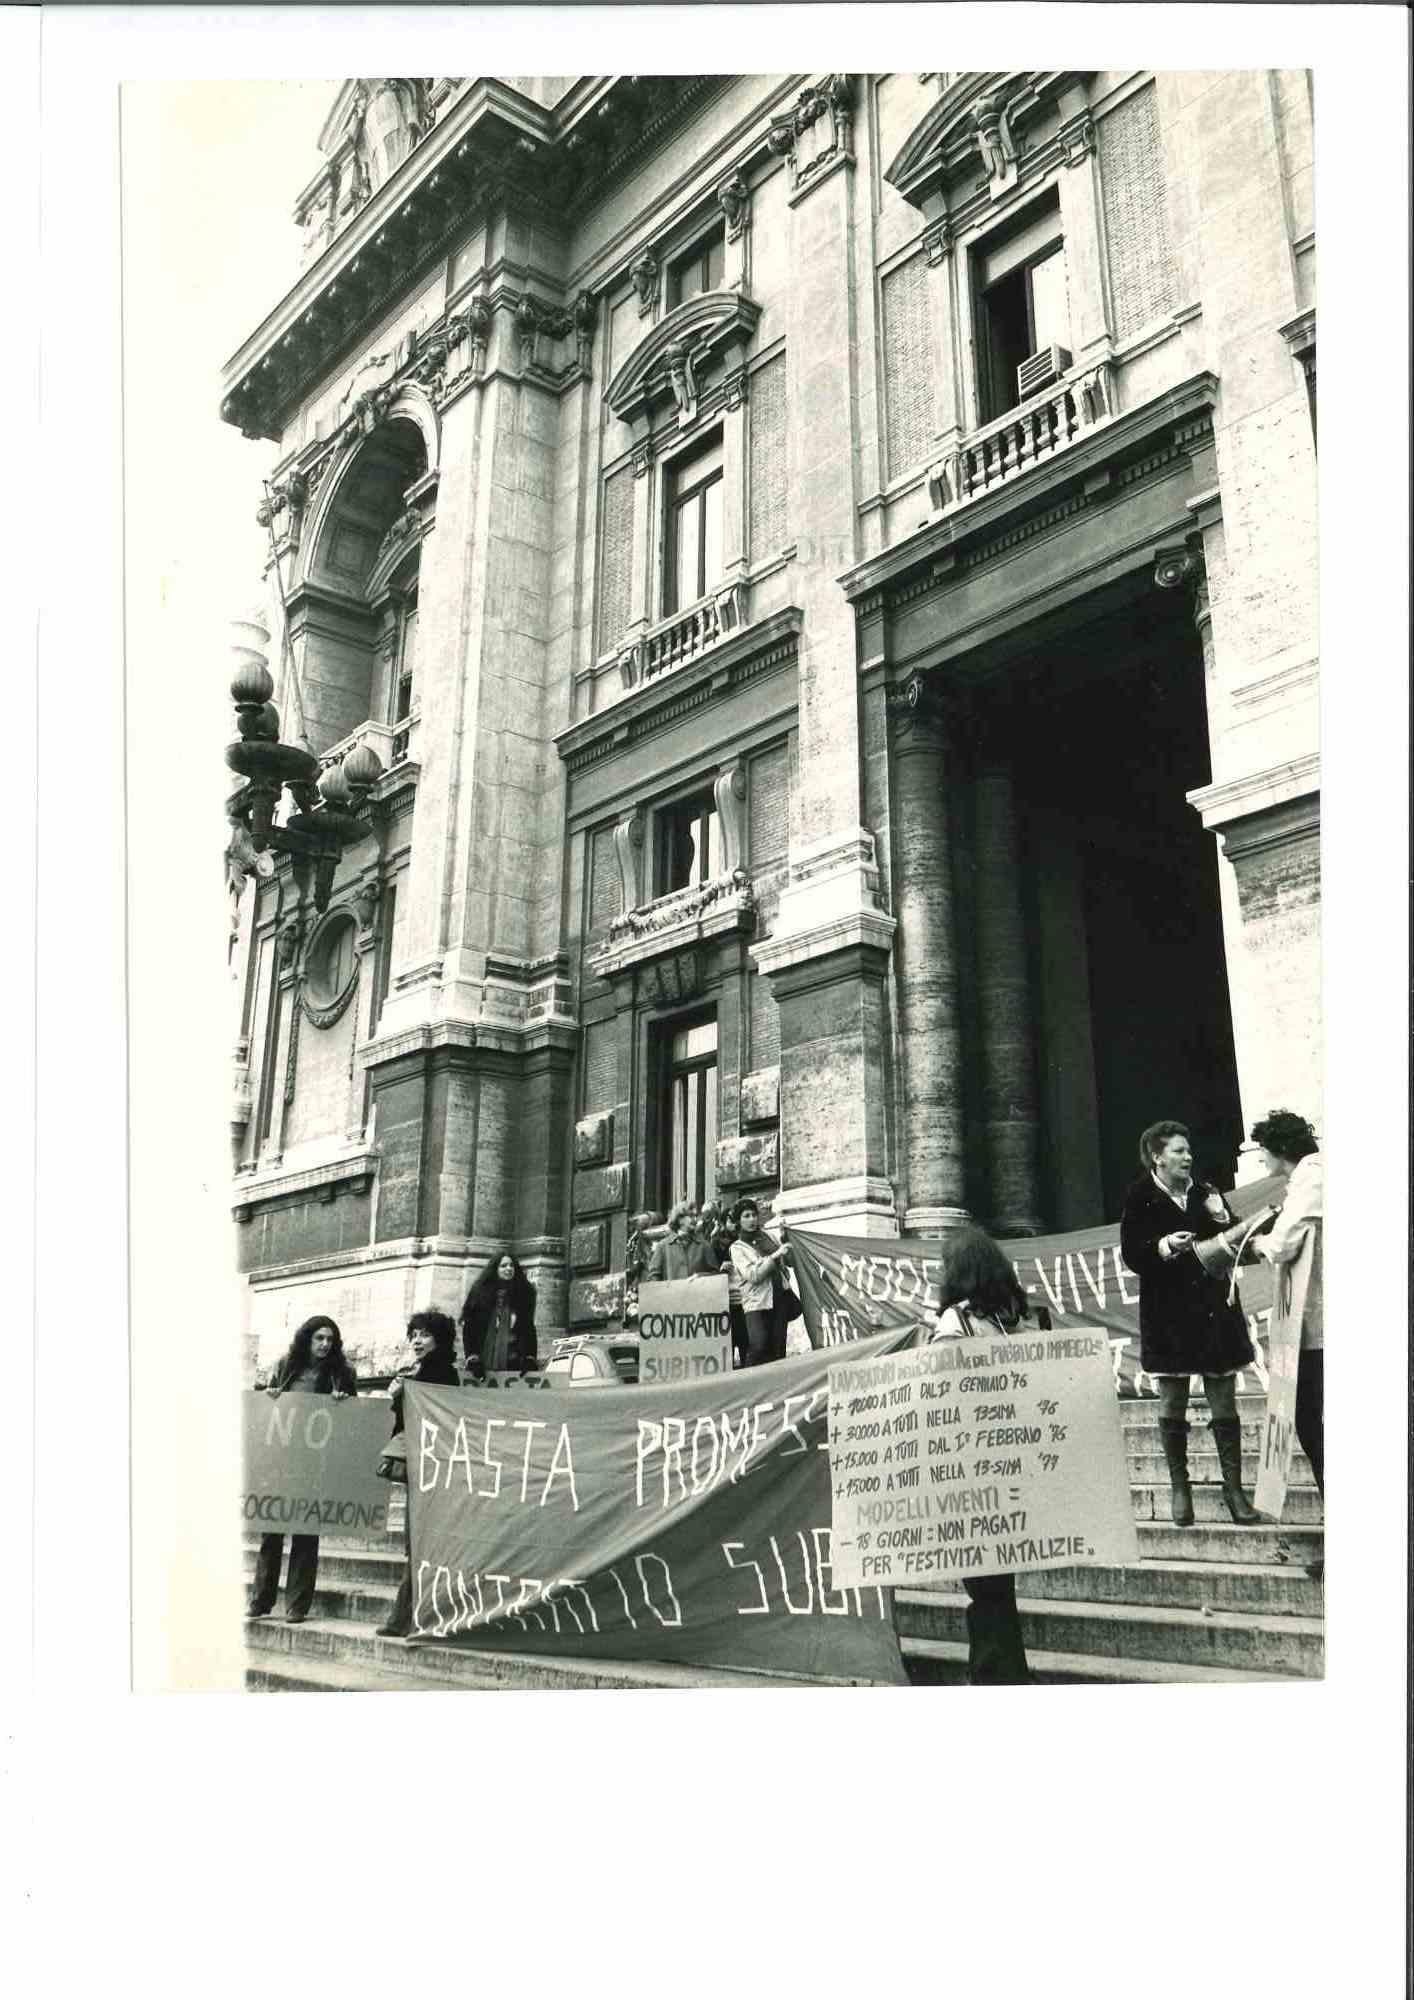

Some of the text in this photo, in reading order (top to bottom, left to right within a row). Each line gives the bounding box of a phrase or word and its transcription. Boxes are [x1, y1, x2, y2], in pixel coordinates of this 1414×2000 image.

[640, 1311, 731, 1340] CONTRATTO
[888, 1384, 912, 1407] TUTTI
[920, 1382, 937, 1399] DAL
[959, 1373, 1007, 1392] GENNAIO
[264, 1406, 334, 1450] NO
[882, 1419, 891, 1436] A
[893, 1409, 919, 1434] TUTTI
[926, 1406, 961, 1427] NELLA
[883, 1446, 893, 1464] A
[894, 1439, 919, 1461] TUTTI
[928, 1437, 951, 1456] DAL
[975, 1425, 1042, 1448] FEBBRAIO
[419, 1416, 581, 1513] BASTA
[886, 1473, 894, 1491] A
[896, 1466, 920, 1488] TUTTI
[930, 1461, 965, 1483] NELLA
[856, 1497, 929, 1526] MODELLI
[935, 1486, 999, 1514] VIVENTI
[876, 1527, 922, 1550] GIORNI
[937, 1520, 965, 1543] NON
[970, 1511, 1027, 1538] PAGATI
[862, 1553, 891, 1577] PER
